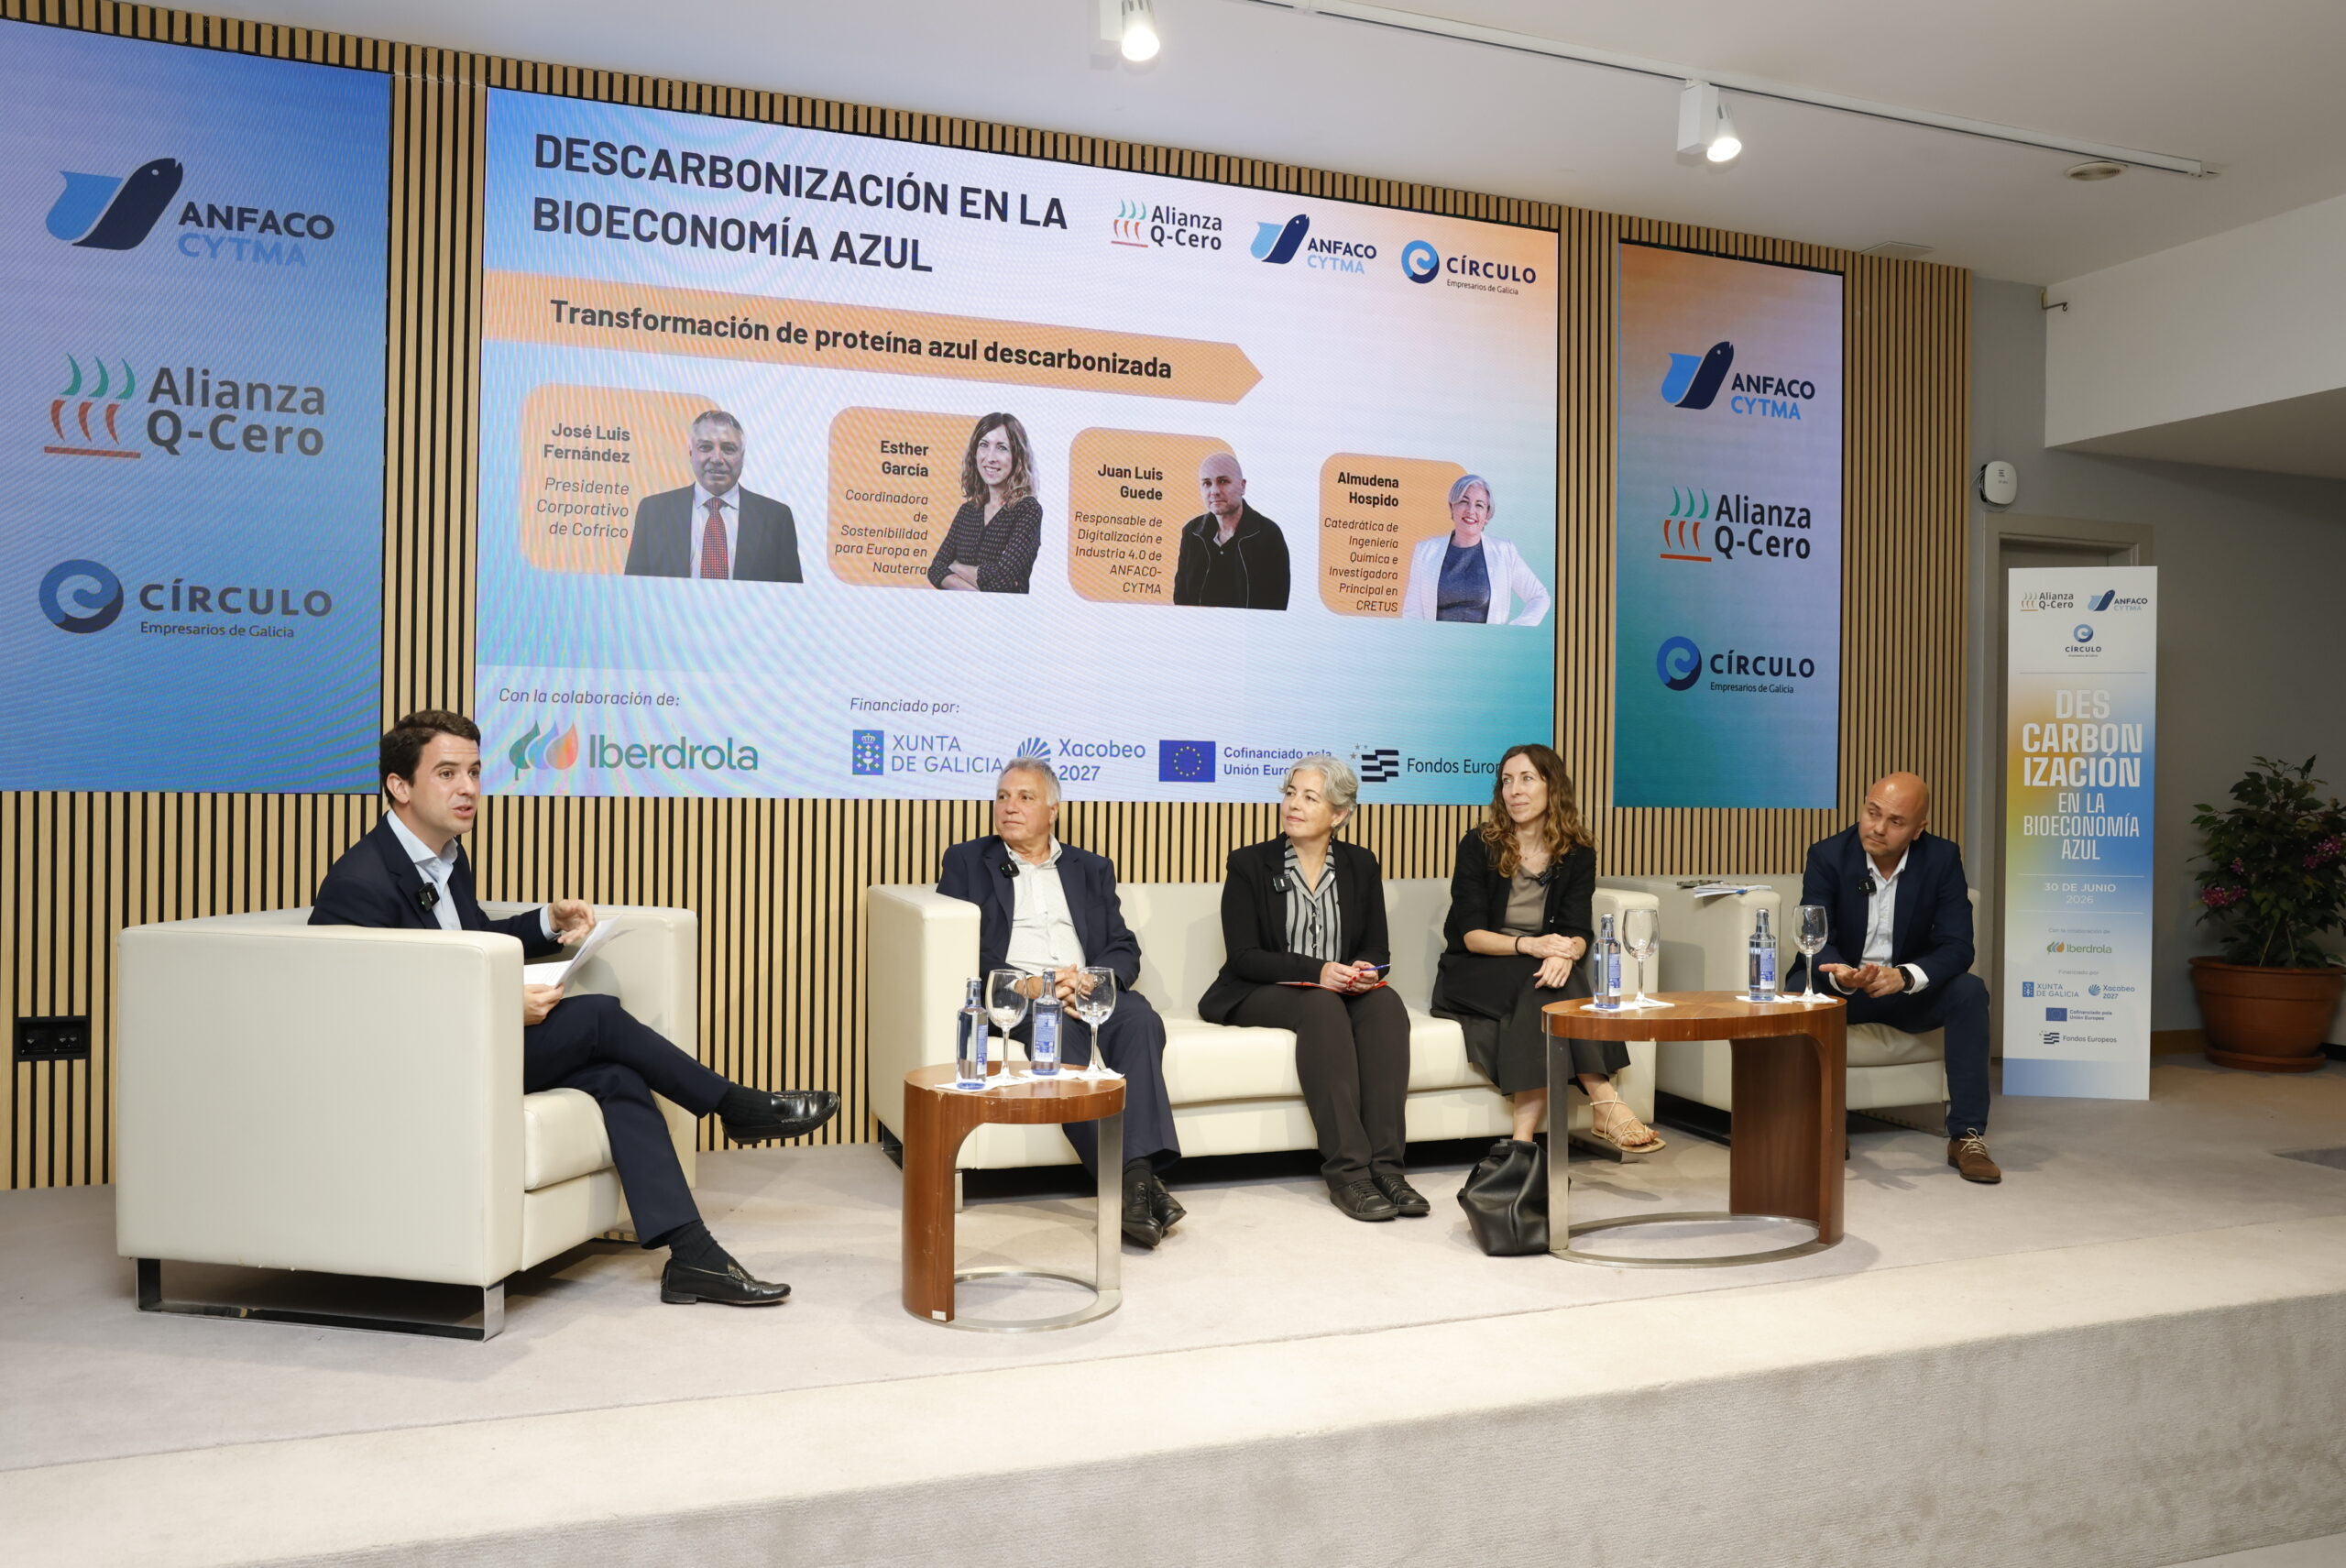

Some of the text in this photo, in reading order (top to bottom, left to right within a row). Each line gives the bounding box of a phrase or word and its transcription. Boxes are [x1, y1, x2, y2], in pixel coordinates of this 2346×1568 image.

[535, 134, 1068, 230] DESCARBONIZACIÓN EN LA
[179, 202, 334, 240] ANFACO
[1151, 205, 1222, 232] Alianza
[534, 198, 932, 272] BIOECONOMÍA AZUL
[1150, 225, 1222, 250] Q-Cero
[178, 232, 307, 268] CYTMA
[1308, 238, 1376, 259] ANFACO
[1307, 254, 1365, 275] CYTMA
[1446, 256, 1536, 284] CÍRCULO
[1446, 279, 1518, 295] Empresarios de Galicia
[551, 300, 1172, 378] Transformación de proteína azul descarbonizada
[148, 367, 326, 415] Alianza
[1731, 373, 1814, 400] ANFACO
[1731, 396, 1801, 420] CYTMA
[147, 410, 324, 456] Q-Cero
[552, 423, 630, 441] José Luis
[543, 444, 630, 463] Fernández
[881, 440, 928, 455] Esther
[882, 462, 928, 477] García
[1098, 465, 1163, 480] Juan Luis
[545, 477, 629, 495] Presidente
[1338, 472, 1398, 488] Almudena
[846, 489, 928, 505] Coordinadora
[1121, 486, 1162, 500] Guede
[1349, 492, 1398, 508] Hospido
[537, 499, 629, 517] Corporativo
[1716, 495, 1811, 529] Alianza
[914, 512, 927, 522] de
[1075, 511, 1162, 527] Responsable de
[1324, 518, 1398, 532] Catedrática de
[549, 522, 628, 538] de Cofrico
[841, 525, 927, 540] Sostenibilidad
[1078, 529, 1162, 543] Digitalización e
[835, 543, 927, 558] para Europa en
[1715, 527, 1811, 559] Q-Cero
[1075, 546, 1162, 561] Industria 4.0 de
[1393, 556, 1398, 565] e
[872, 563, 927, 575] Nauterra
[1110, 565, 1161, 577] ANFACO-
[1330, 566, 1398, 580] Investigadora
[1123, 583, 1161, 594] CYTMA
[1339, 583, 1398, 597] Principal en
[2039, 592, 2074, 600] Alianza
[140, 579, 333, 617] CÍRCULO
[1356, 600, 1398, 612] CRETUS
[2039, 601, 2074, 609] Q-Cero
[141, 622, 294, 639] Empresarios de Galicia
[1710, 651, 1814, 678] CÍRCULO
[1710, 682, 1793, 694] Empresarios de Galicia
[499, 688, 680, 707] Con la colaboración de:
[2056, 690, 2110, 719] DES
[850, 698, 959, 715] Financiado por:
[893, 735, 960, 751] XUNTA
[2023, 723, 2142, 753] CARBON
[589, 734, 758, 771] Iberdrola
[1058, 740, 1146, 758] Xacobeo
[1224, 747, 1302, 759] Cofinanciado
[892, 757, 1003, 773] DE GALICIA
[1224, 764, 1289, 775] Unión Euro
[1408, 758, 1501, 777] Fondos Europ
[2024, 752, 2140, 787] IZACIÓN
[1058, 766, 1100, 781] 2027
[2058, 793, 2105, 813] EN LA
[2024, 813, 2140, 837] BIOECONOMÍA
[2062, 839, 2100, 860] AZUL
[2063, 883, 2077, 892] DE
[2081, 883, 2116, 893] JUNIO
[2066, 895, 2093, 904] 2026
[2067, 944, 2111, 953] Iberdrola
